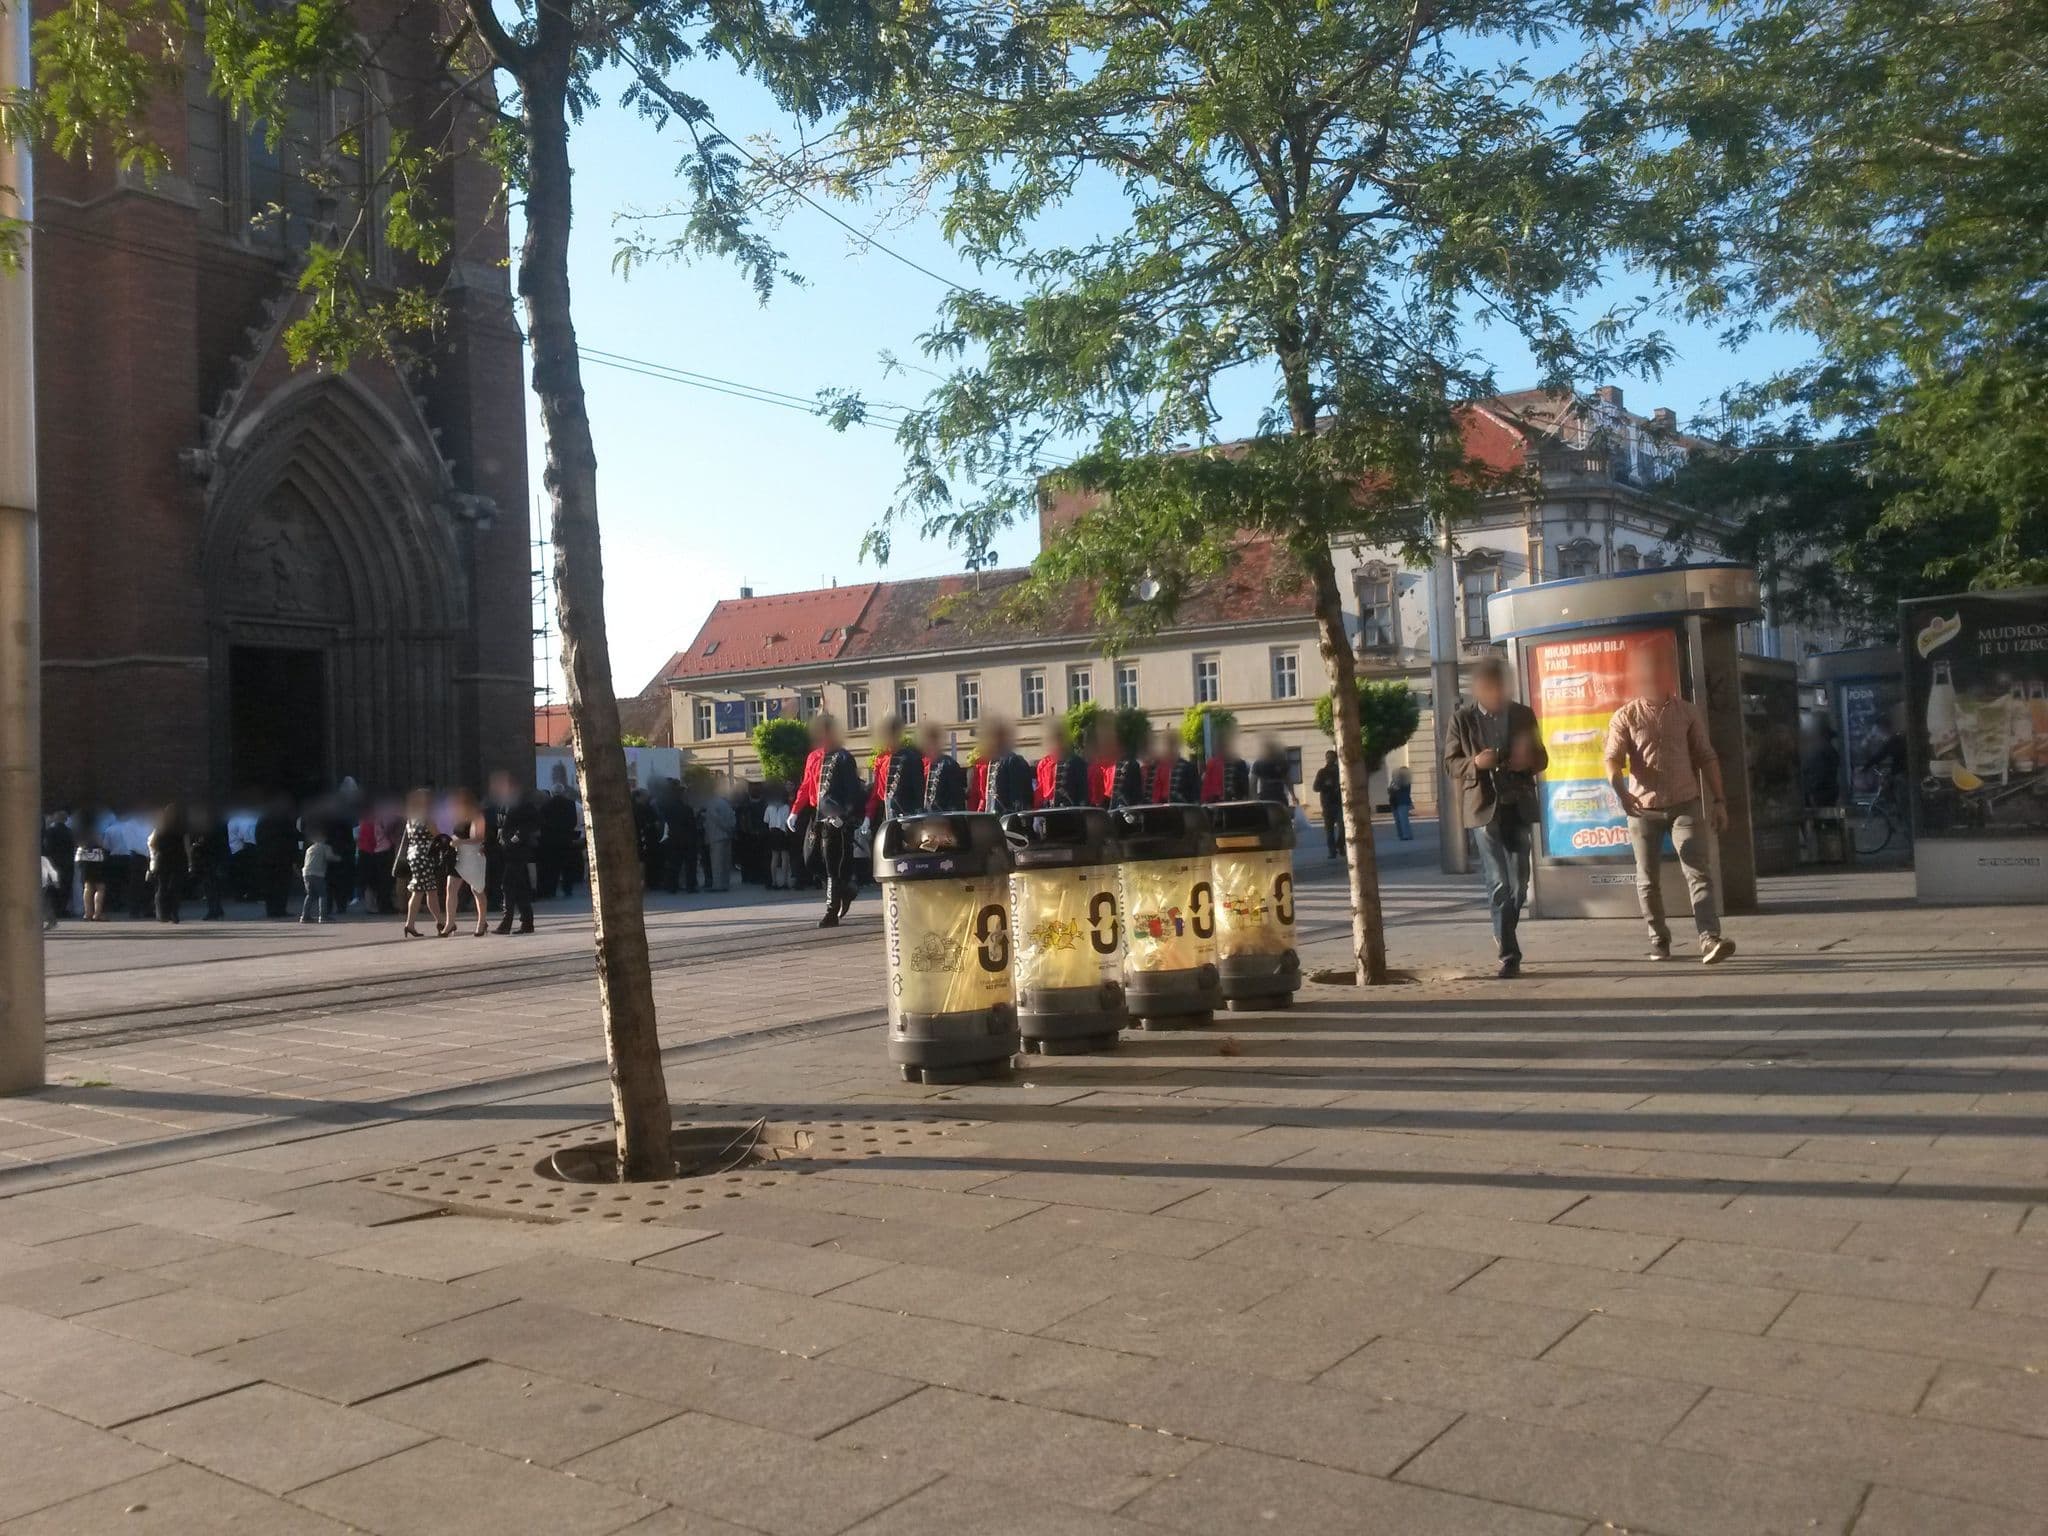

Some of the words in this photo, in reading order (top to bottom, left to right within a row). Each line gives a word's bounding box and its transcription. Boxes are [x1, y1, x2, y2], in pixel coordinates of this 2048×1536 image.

[1544, 644, 1571, 659] NIKAD
[1998, 641, 2009, 654] U
[1573, 827, 1631, 847] CEDEVIT
[889, 887, 901, 968] UNIKOM
